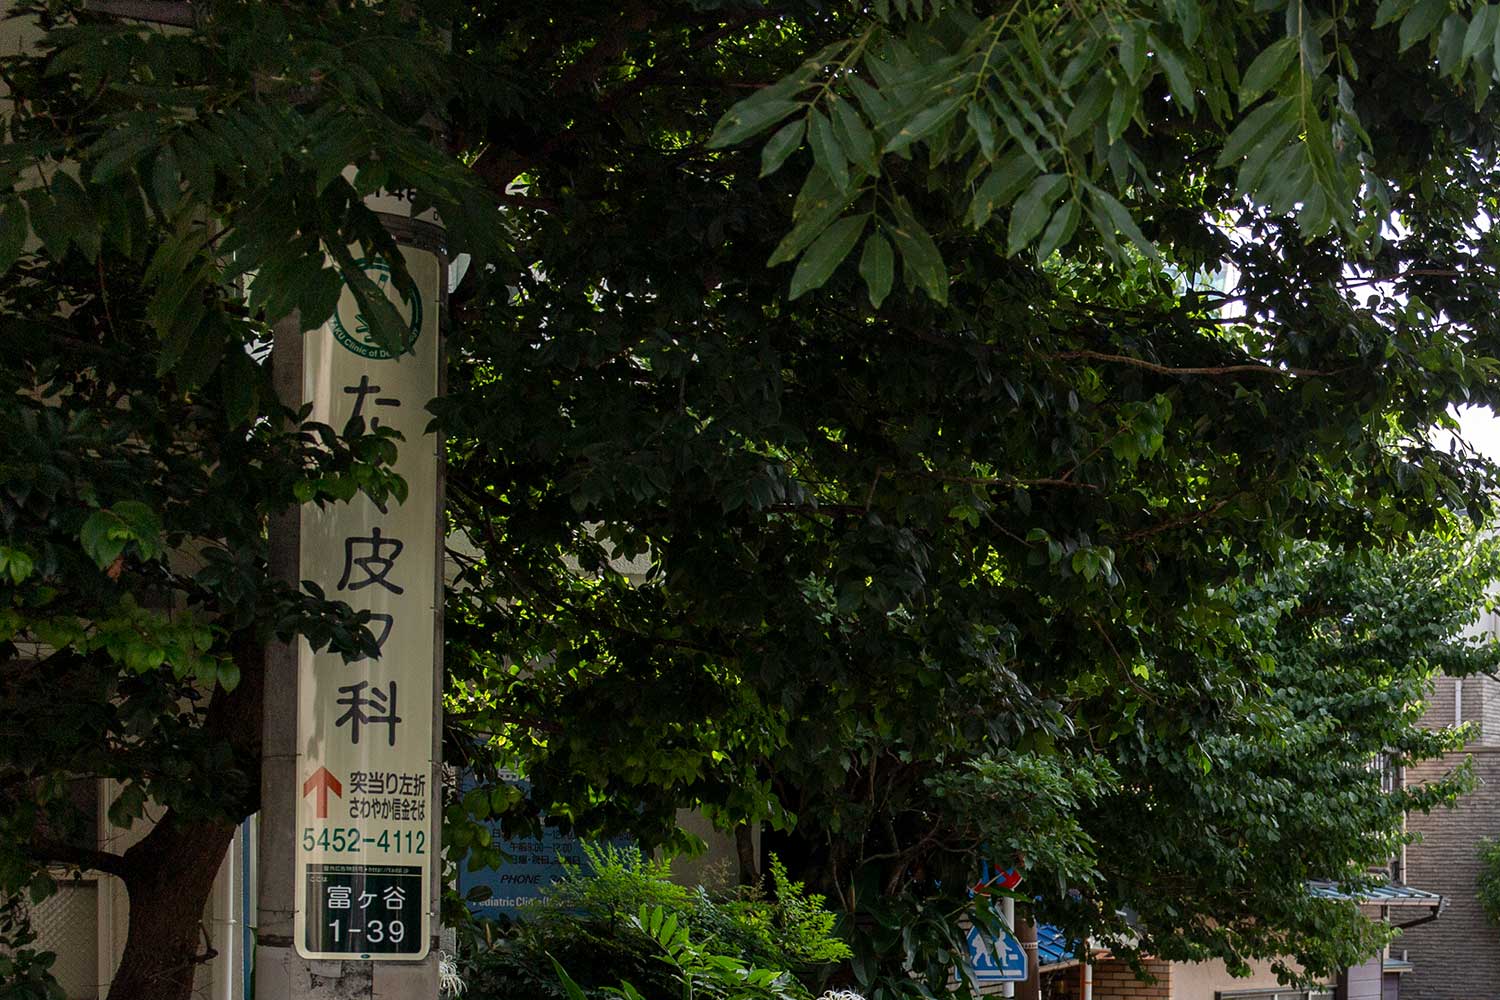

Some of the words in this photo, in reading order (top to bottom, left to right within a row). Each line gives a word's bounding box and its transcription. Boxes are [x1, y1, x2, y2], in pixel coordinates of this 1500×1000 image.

[344, 338, 367, 356] Clinic
[368, 349, 378, 358] of
[350, 770, 426, 797] 突当り左折
[349, 797, 426, 821] さわやか信金そば
[303, 828, 425, 854] 5452-4112
[500, 874, 541, 884] PHONE
[472, 897, 515, 907] ediatric
[328, 919, 405, 943] 1-39
